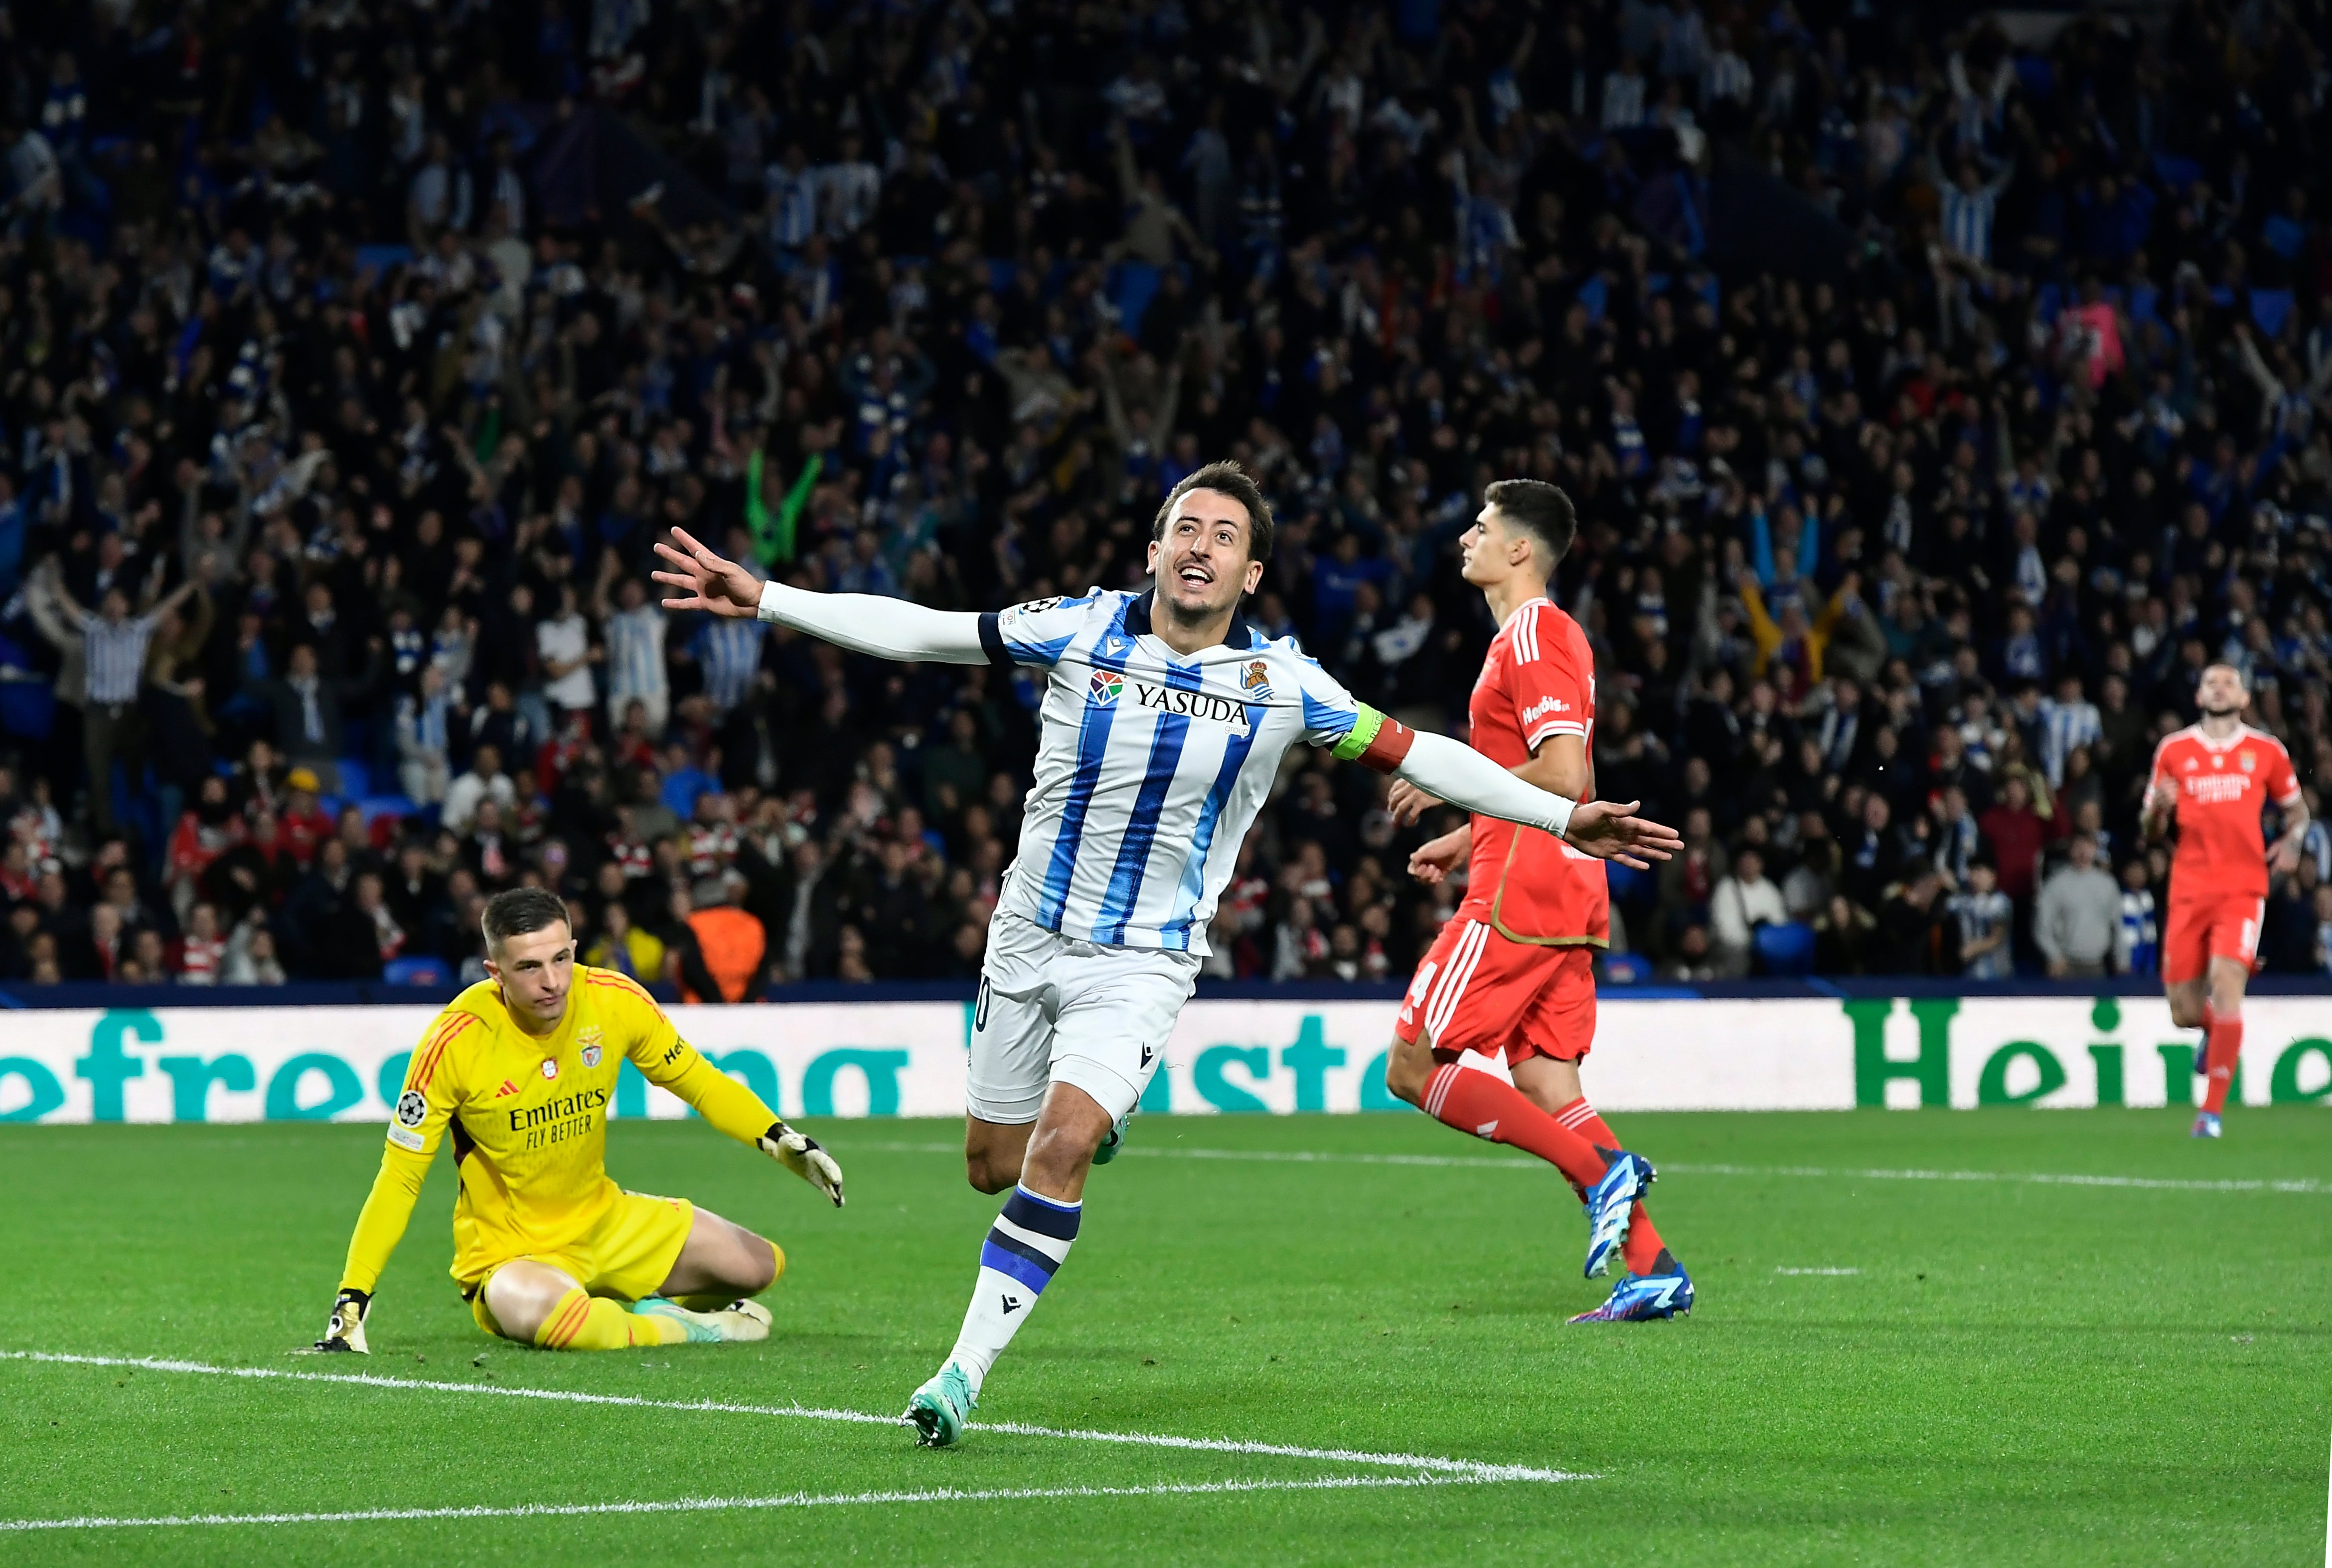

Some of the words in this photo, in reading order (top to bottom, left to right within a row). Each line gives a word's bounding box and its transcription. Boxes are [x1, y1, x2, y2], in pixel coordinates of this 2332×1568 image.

[1135, 683, 1249, 726] YASUDA
[1224, 725, 1249, 736] group
[1410, 961, 1438, 1008] 4
[509, 1089, 606, 1132] Emirates
[527, 1128, 546, 1150] FLY
[551, 1115, 592, 1143] BETTER
